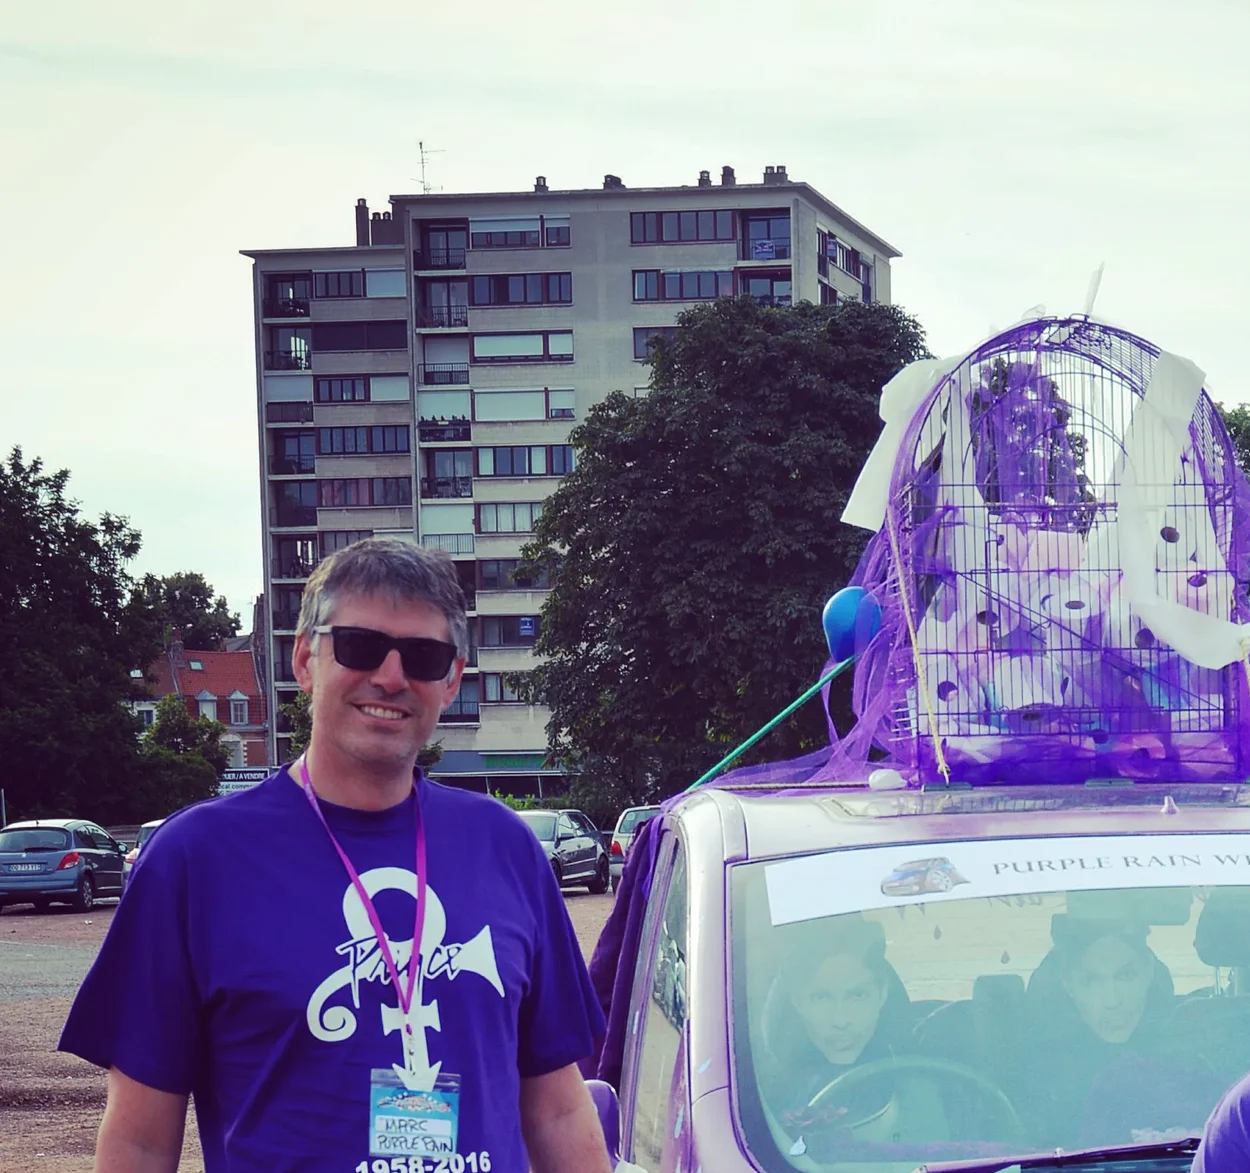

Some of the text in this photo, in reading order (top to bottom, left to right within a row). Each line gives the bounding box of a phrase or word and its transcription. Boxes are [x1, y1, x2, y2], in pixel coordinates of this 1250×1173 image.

[992, 856, 1114, 876] PURPLE
[1122, 854, 1203, 868] RAIN
[385, 1119, 428, 1133] MARC
